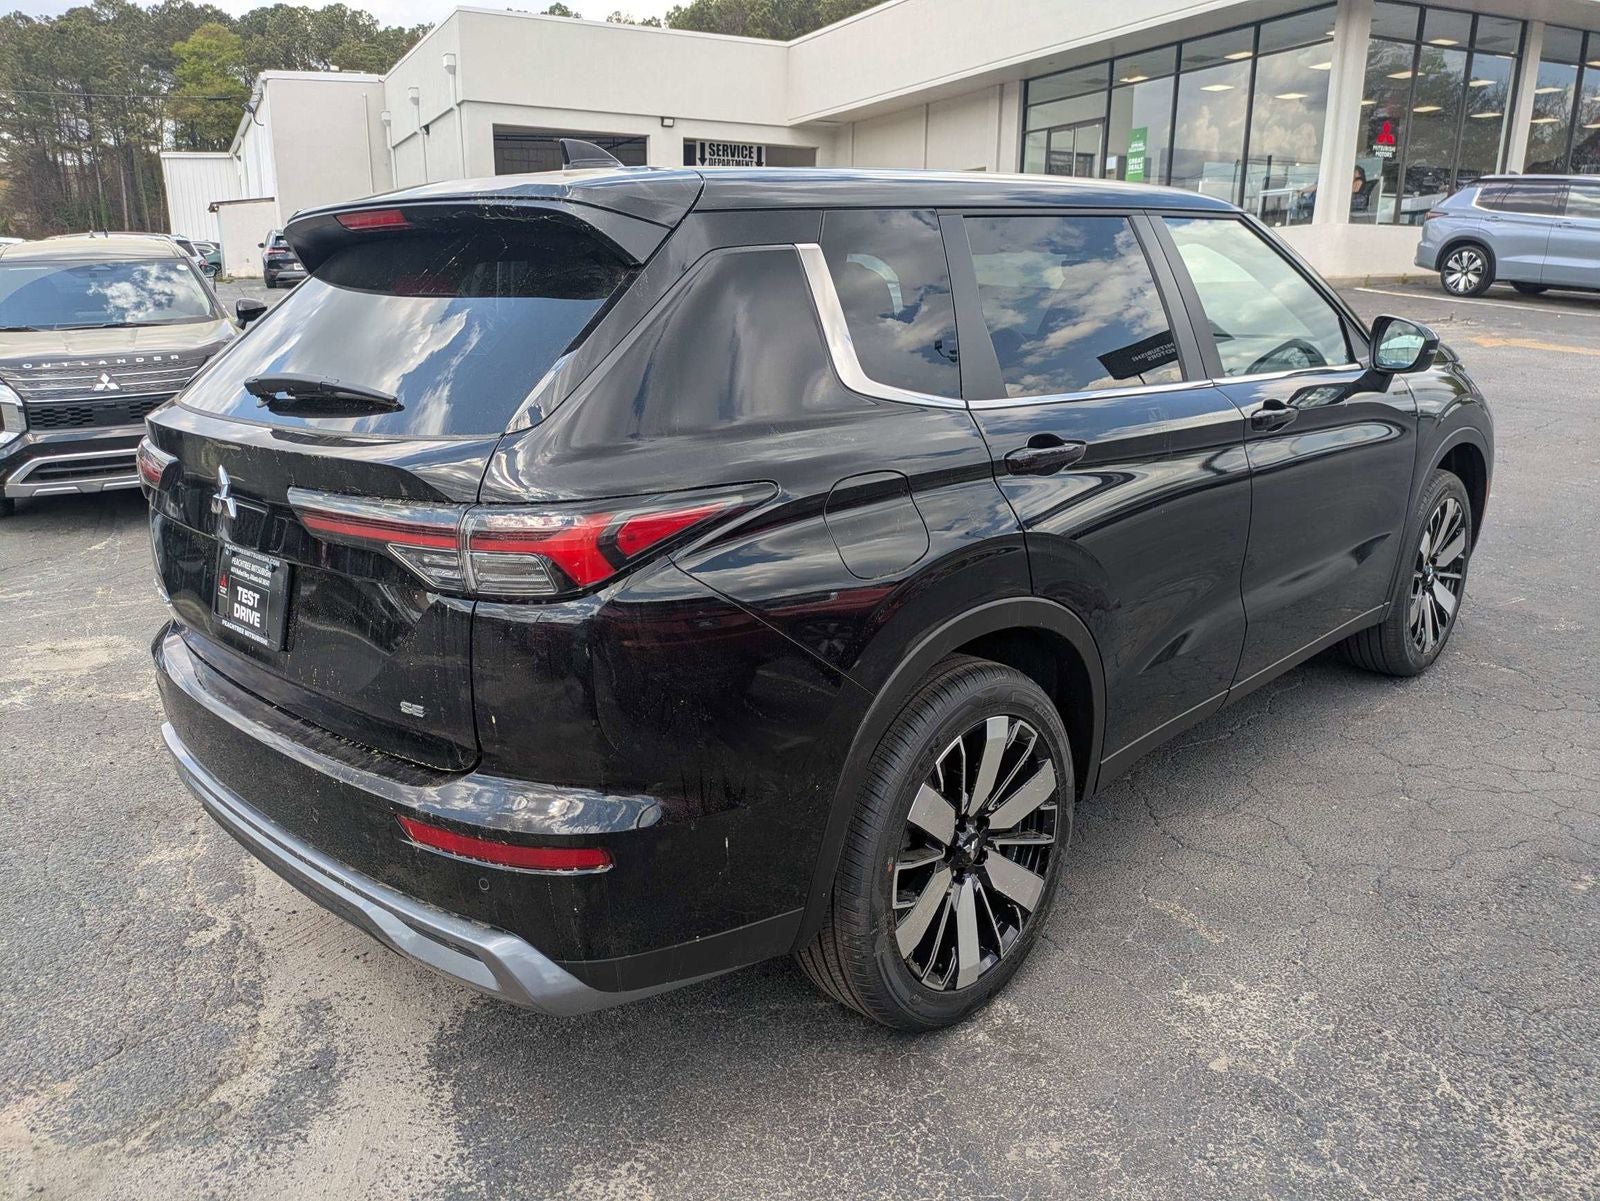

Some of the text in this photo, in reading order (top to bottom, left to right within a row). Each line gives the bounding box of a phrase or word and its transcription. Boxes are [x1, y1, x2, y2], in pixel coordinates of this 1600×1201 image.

[708, 143, 754, 159] SERVICE
[708, 158, 754, 167] DEPARTMENT
[1128, 163, 1144, 171] DEALS
[22, 354, 180, 369] OUTLANDER
[231, 557, 251, 570] PEACHTREE
[251, 562, 272, 579] MITSUBISHI
[237, 585, 260, 608] TEST
[233, 602, 261, 628] DRIVE
[222, 619, 245, 635] PEACHTREE
[400, 701, 425, 718] SE
